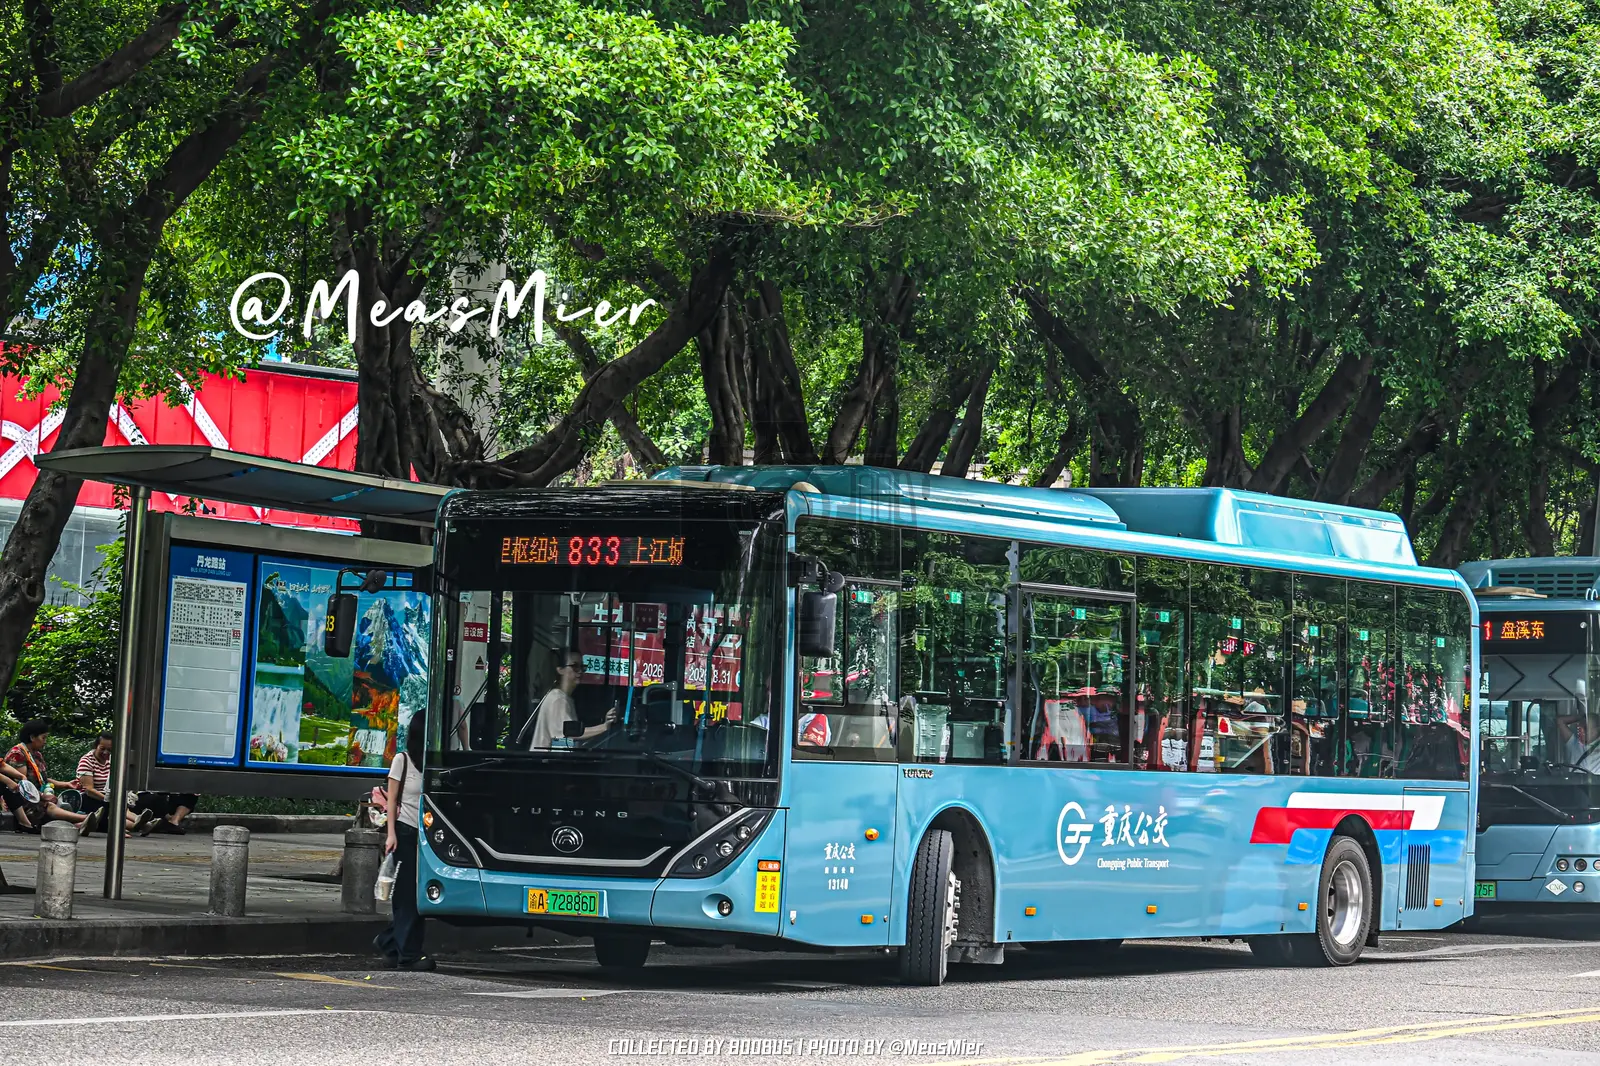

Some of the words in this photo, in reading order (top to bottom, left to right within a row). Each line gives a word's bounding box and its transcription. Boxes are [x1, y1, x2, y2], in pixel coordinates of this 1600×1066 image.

[568, 536, 622, 566] 833
[1500, 620, 1545, 640] 盘溪东
[511, 806, 628, 819] YUTONG
[1099, 804, 1170, 848] 重庆公交
[823, 842, 857, 861] 重庆公交
[1097, 858, 1126, 871] Chongqing
[1126, 858, 1143, 869] Public
[1143, 859, 1170, 871] Transport
[1549, 883, 1565, 891] CNG
